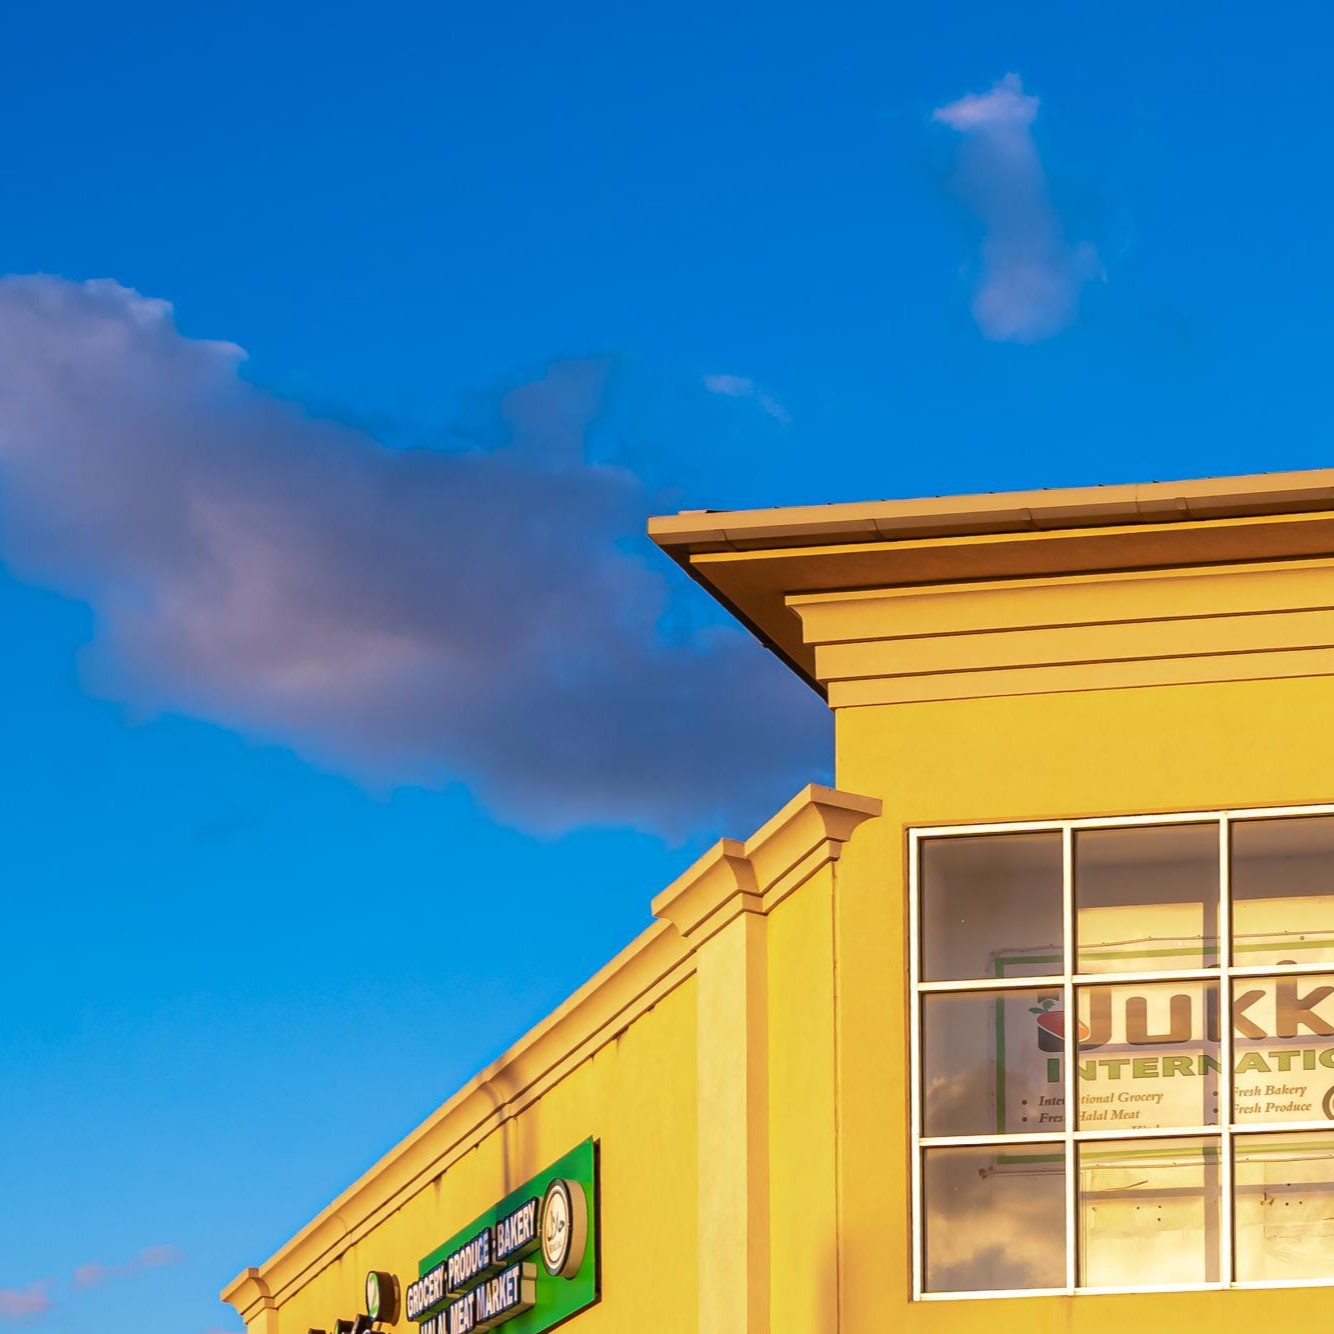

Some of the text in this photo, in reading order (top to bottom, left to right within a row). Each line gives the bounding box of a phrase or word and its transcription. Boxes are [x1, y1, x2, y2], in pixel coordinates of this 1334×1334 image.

[1264, 1084, 1307, 1095] Bakery
[1038, 1091, 1165, 1107] Intertional Grocery
[1264, 1098, 1312, 1110] Produce
[1038, 1111, 1067, 1125] Fres
[1110, 1108, 1141, 1120] Meat
[407, 1200, 537, 1318] GROCERY PRODUCE BAKERY
[476, 1265, 521, 1322] MARKET
